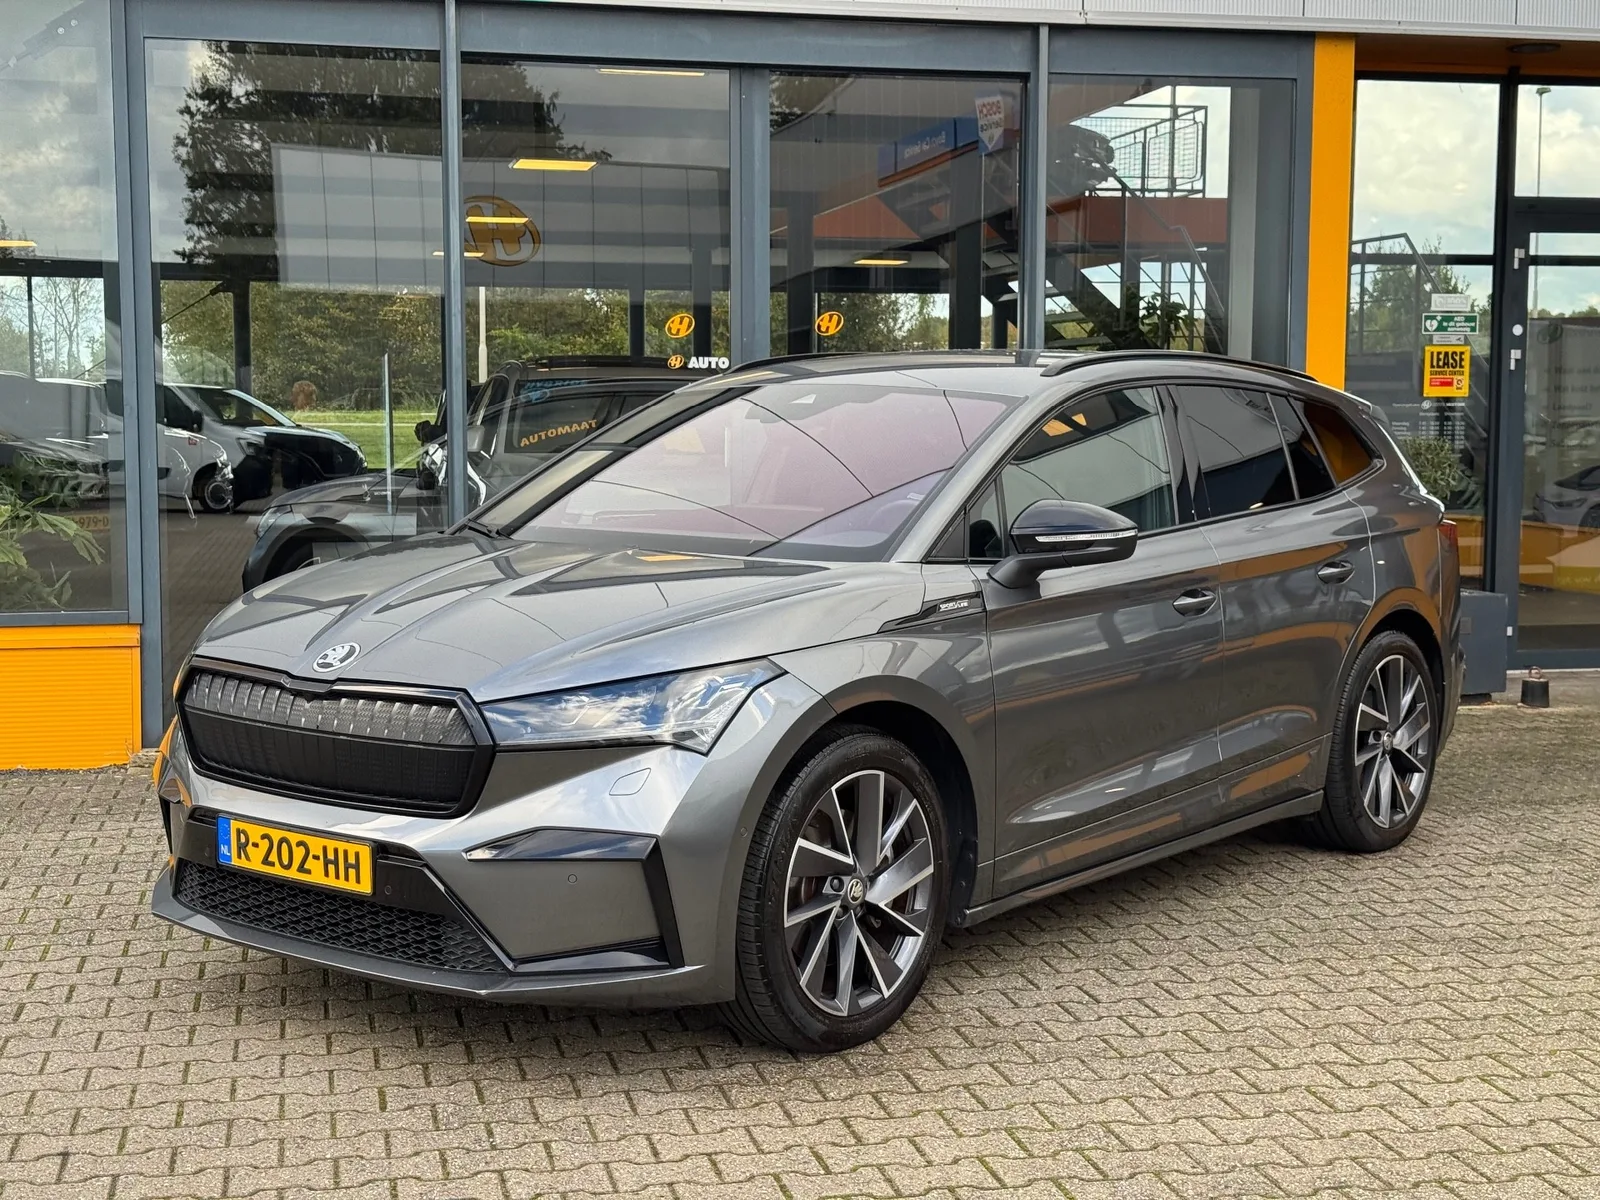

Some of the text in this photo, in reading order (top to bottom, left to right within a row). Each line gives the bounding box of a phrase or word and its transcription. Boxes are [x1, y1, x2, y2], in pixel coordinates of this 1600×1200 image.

[688, 356, 730, 368] AUTO
[1430, 351, 1465, 369] LEASE
[520, 419, 597, 447] AUTOMAAT
[220, 827, 361, 885] NL R-202-HH
